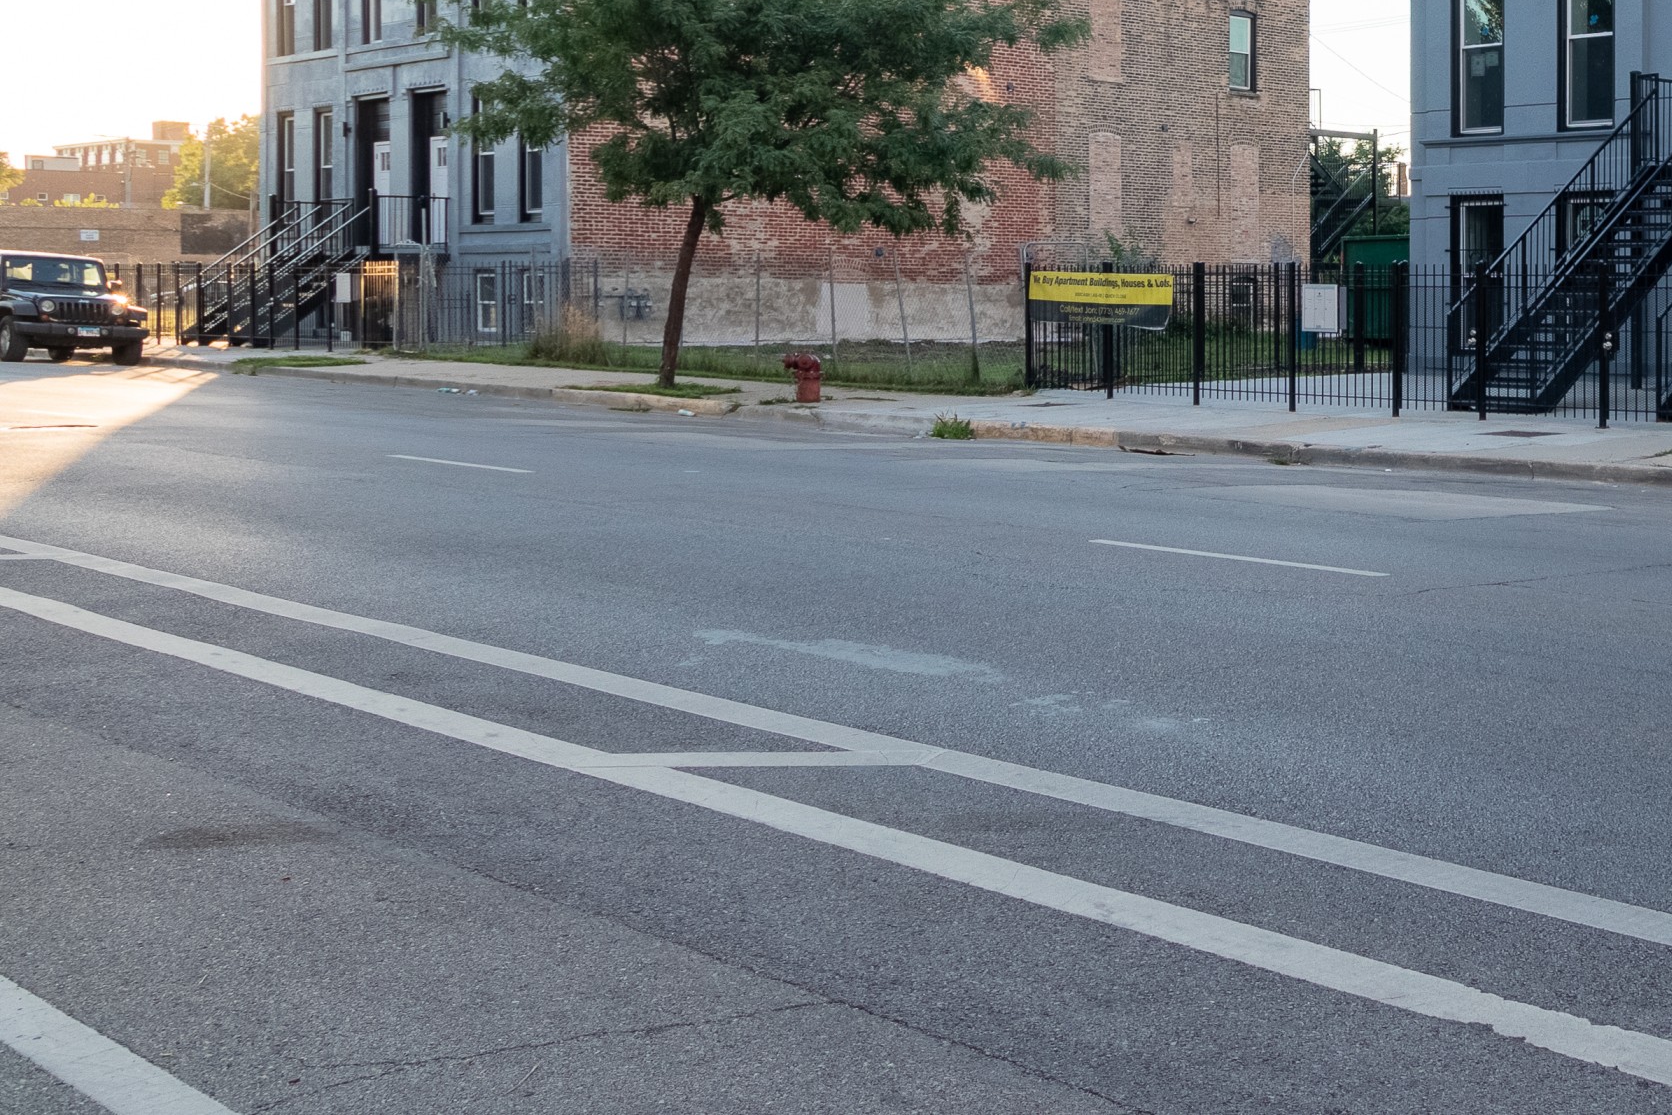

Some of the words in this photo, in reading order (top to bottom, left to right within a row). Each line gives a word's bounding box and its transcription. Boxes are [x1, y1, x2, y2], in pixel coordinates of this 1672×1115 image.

[1042, 275, 1053, 286] Buy
[1055, 276, 1088, 286] Apartment
[1090, 277, 1120, 289] Buildings,
[1121, 278, 1145, 288] Houses
[1147, 279, 1153, 288] &
[1155, 279, 1172, 288] Lots.
[1099, 306, 1113, 316] (773)
